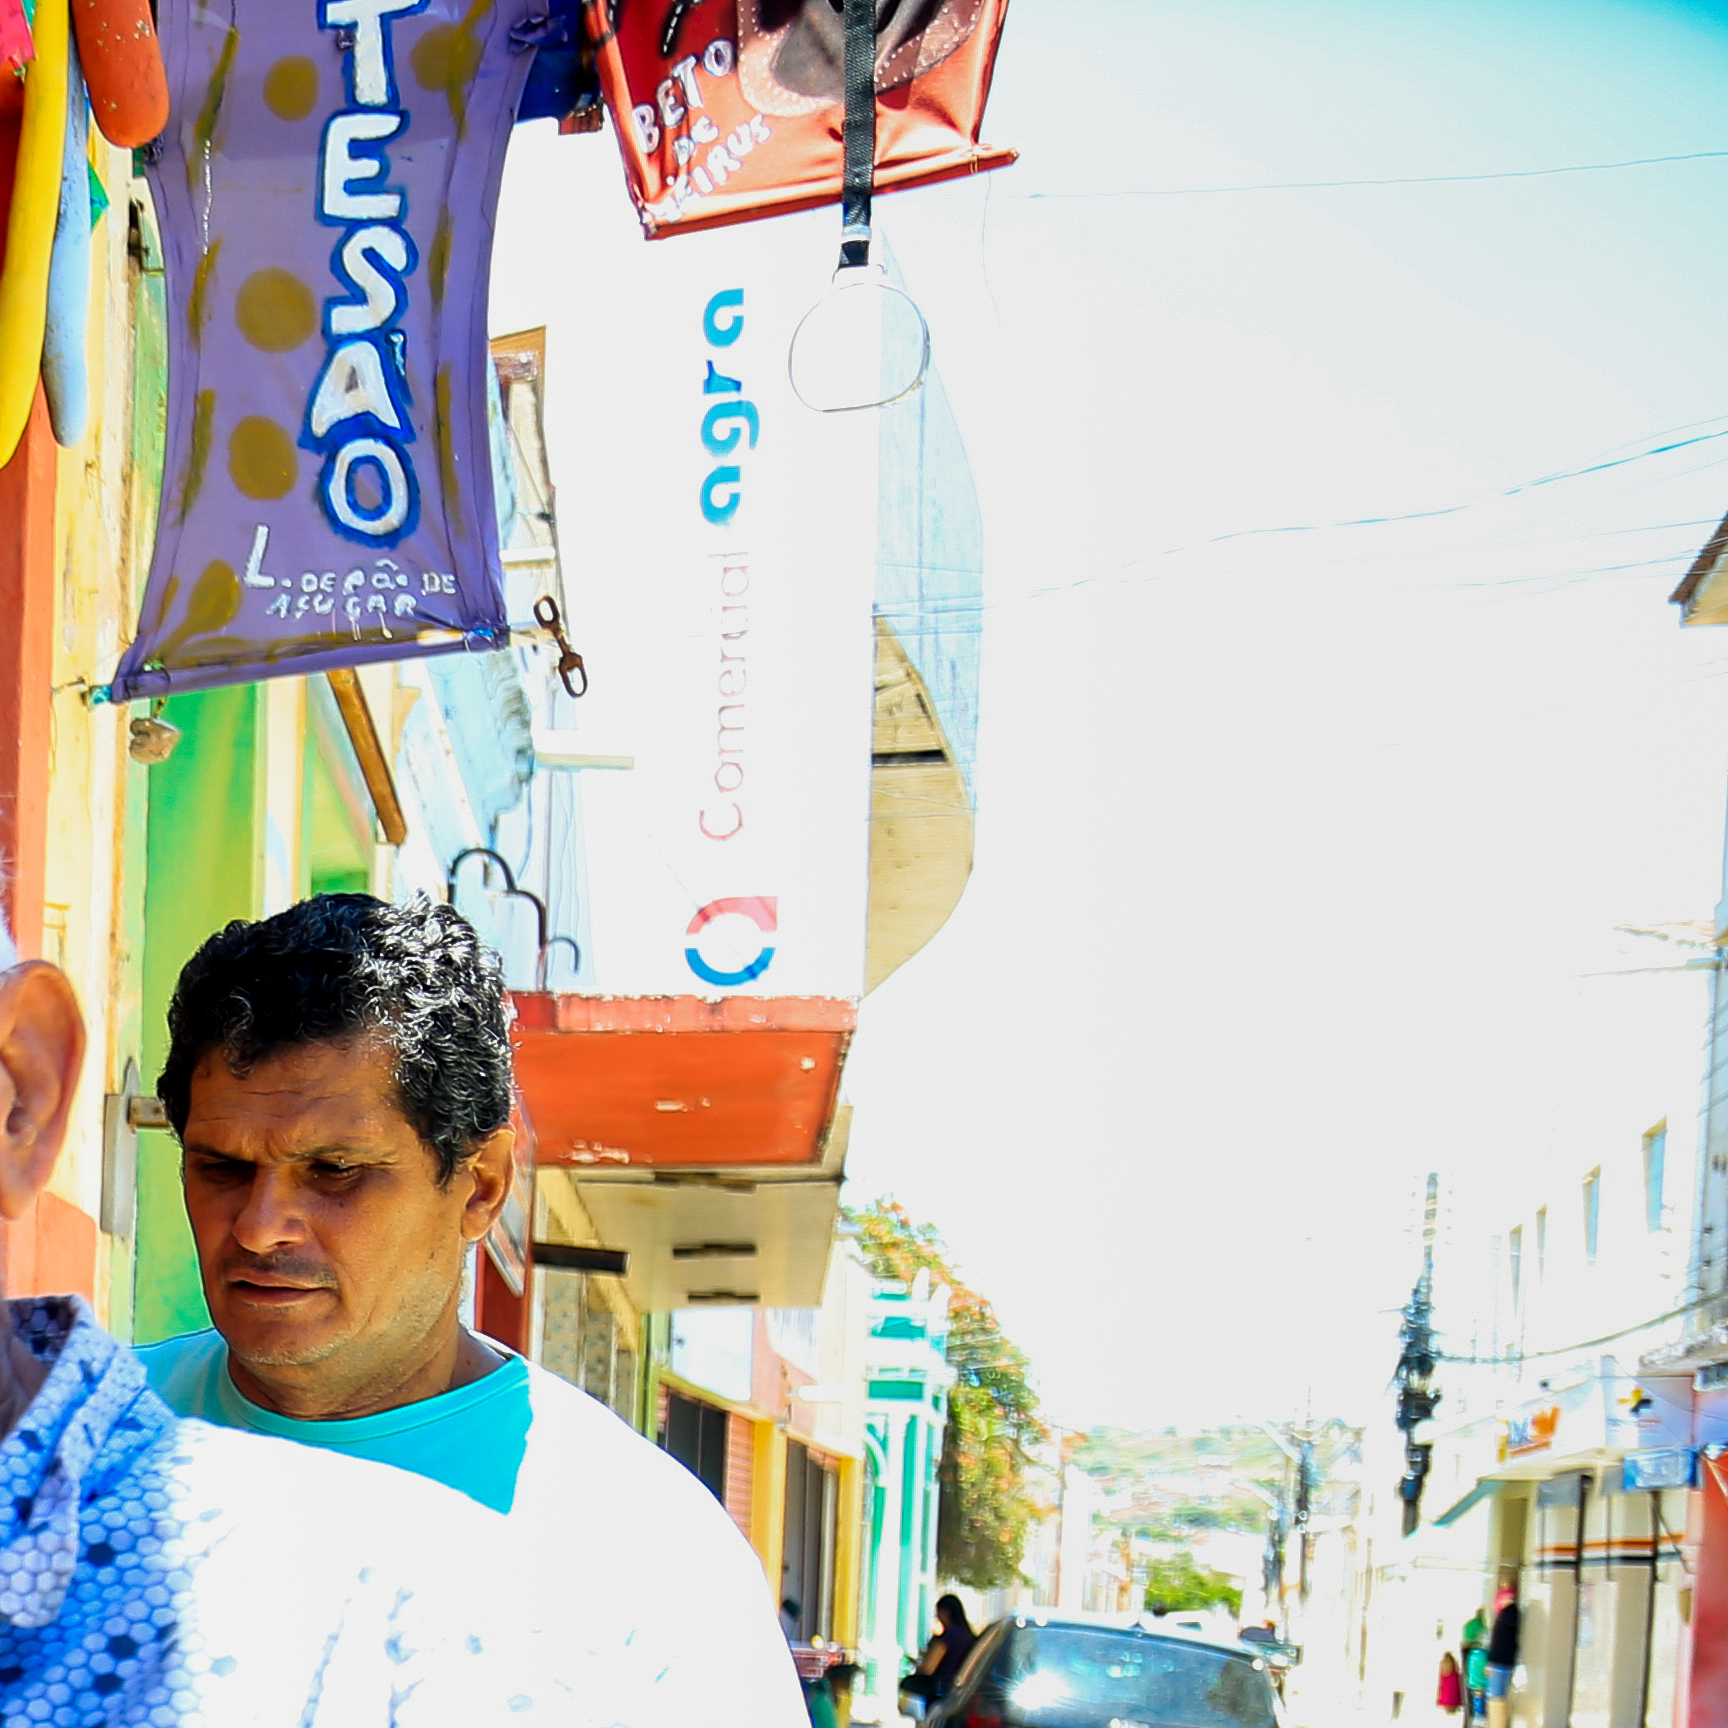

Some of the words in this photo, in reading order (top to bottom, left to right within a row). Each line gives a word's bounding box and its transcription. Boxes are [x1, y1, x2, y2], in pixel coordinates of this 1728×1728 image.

[632, 39, 735, 153] BETO
[699, 287, 760, 528] agra
[421, 572, 456, 596] DE
[699, 550, 749, 842] Comercial
